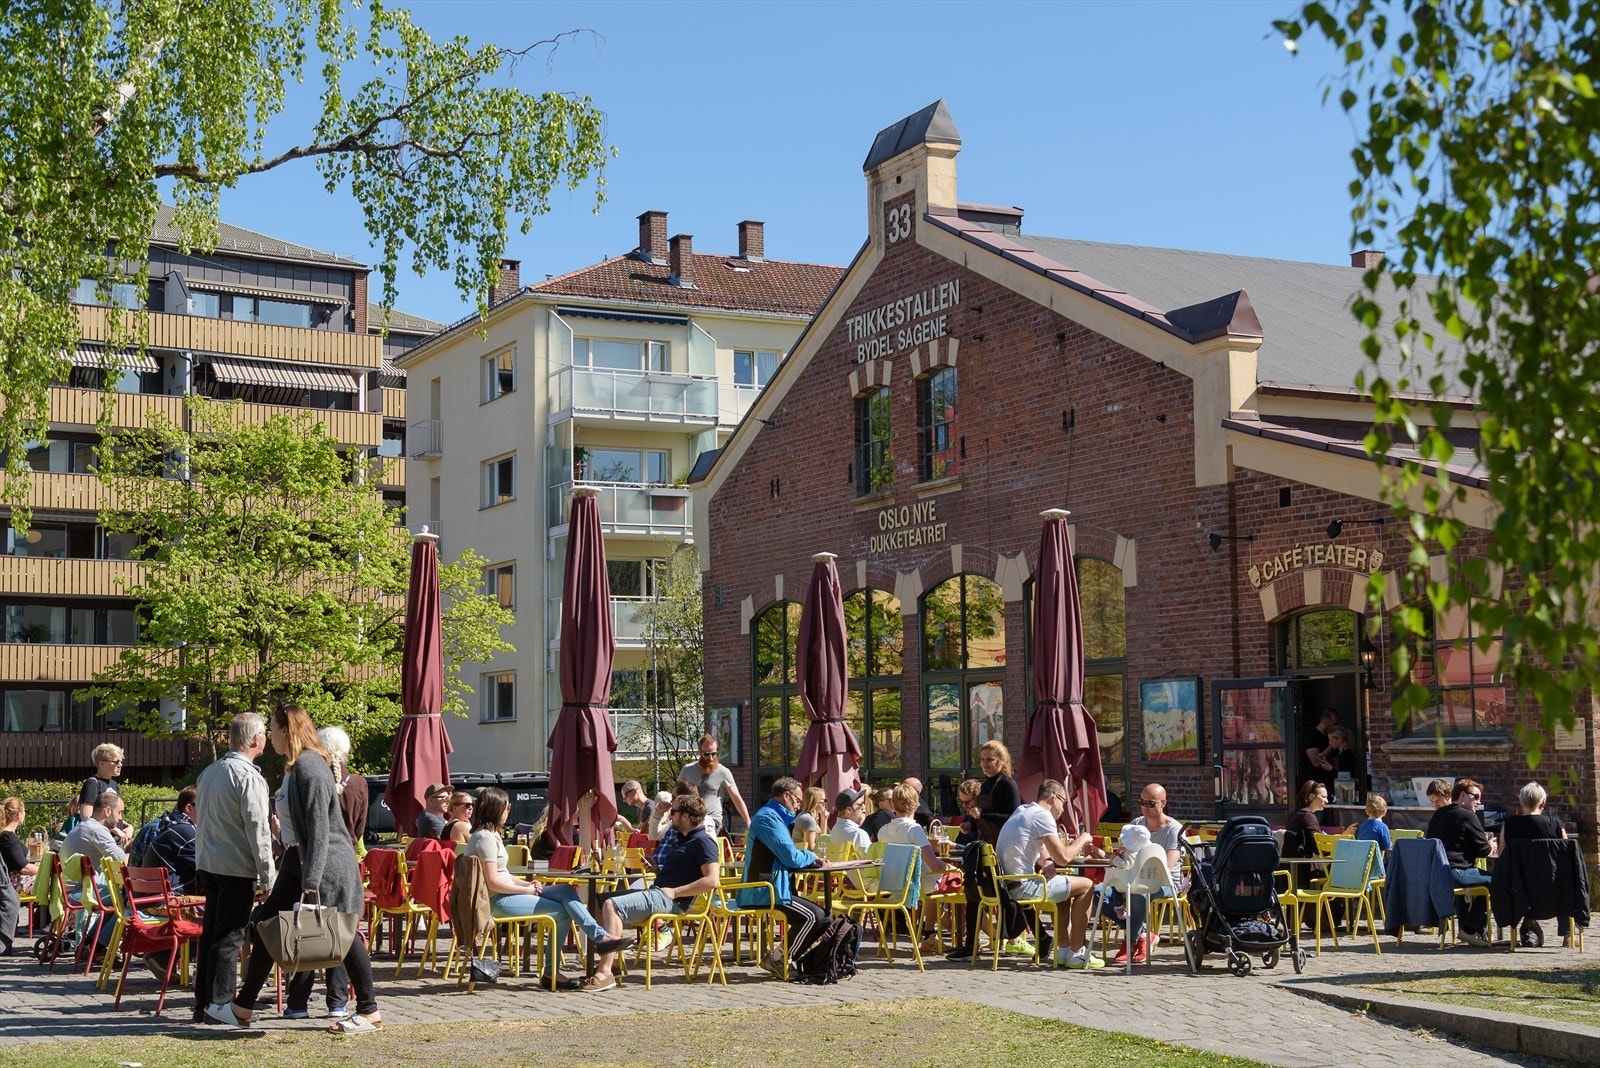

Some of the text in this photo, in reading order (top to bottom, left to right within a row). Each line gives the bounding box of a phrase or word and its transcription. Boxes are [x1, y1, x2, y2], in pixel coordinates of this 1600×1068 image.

[888, 203, 912, 243] 33
[846, 279, 960, 342] TRIKKESTALLEN
[857, 315, 947, 364] BYDEL SAGENE
[879, 500, 937, 531] OSLO NYE
[870, 522, 947, 553] DUKKETEATRET
[1262, 543, 1367, 580] CAFÉ TEATER
[517, 793, 529, 801] NG
